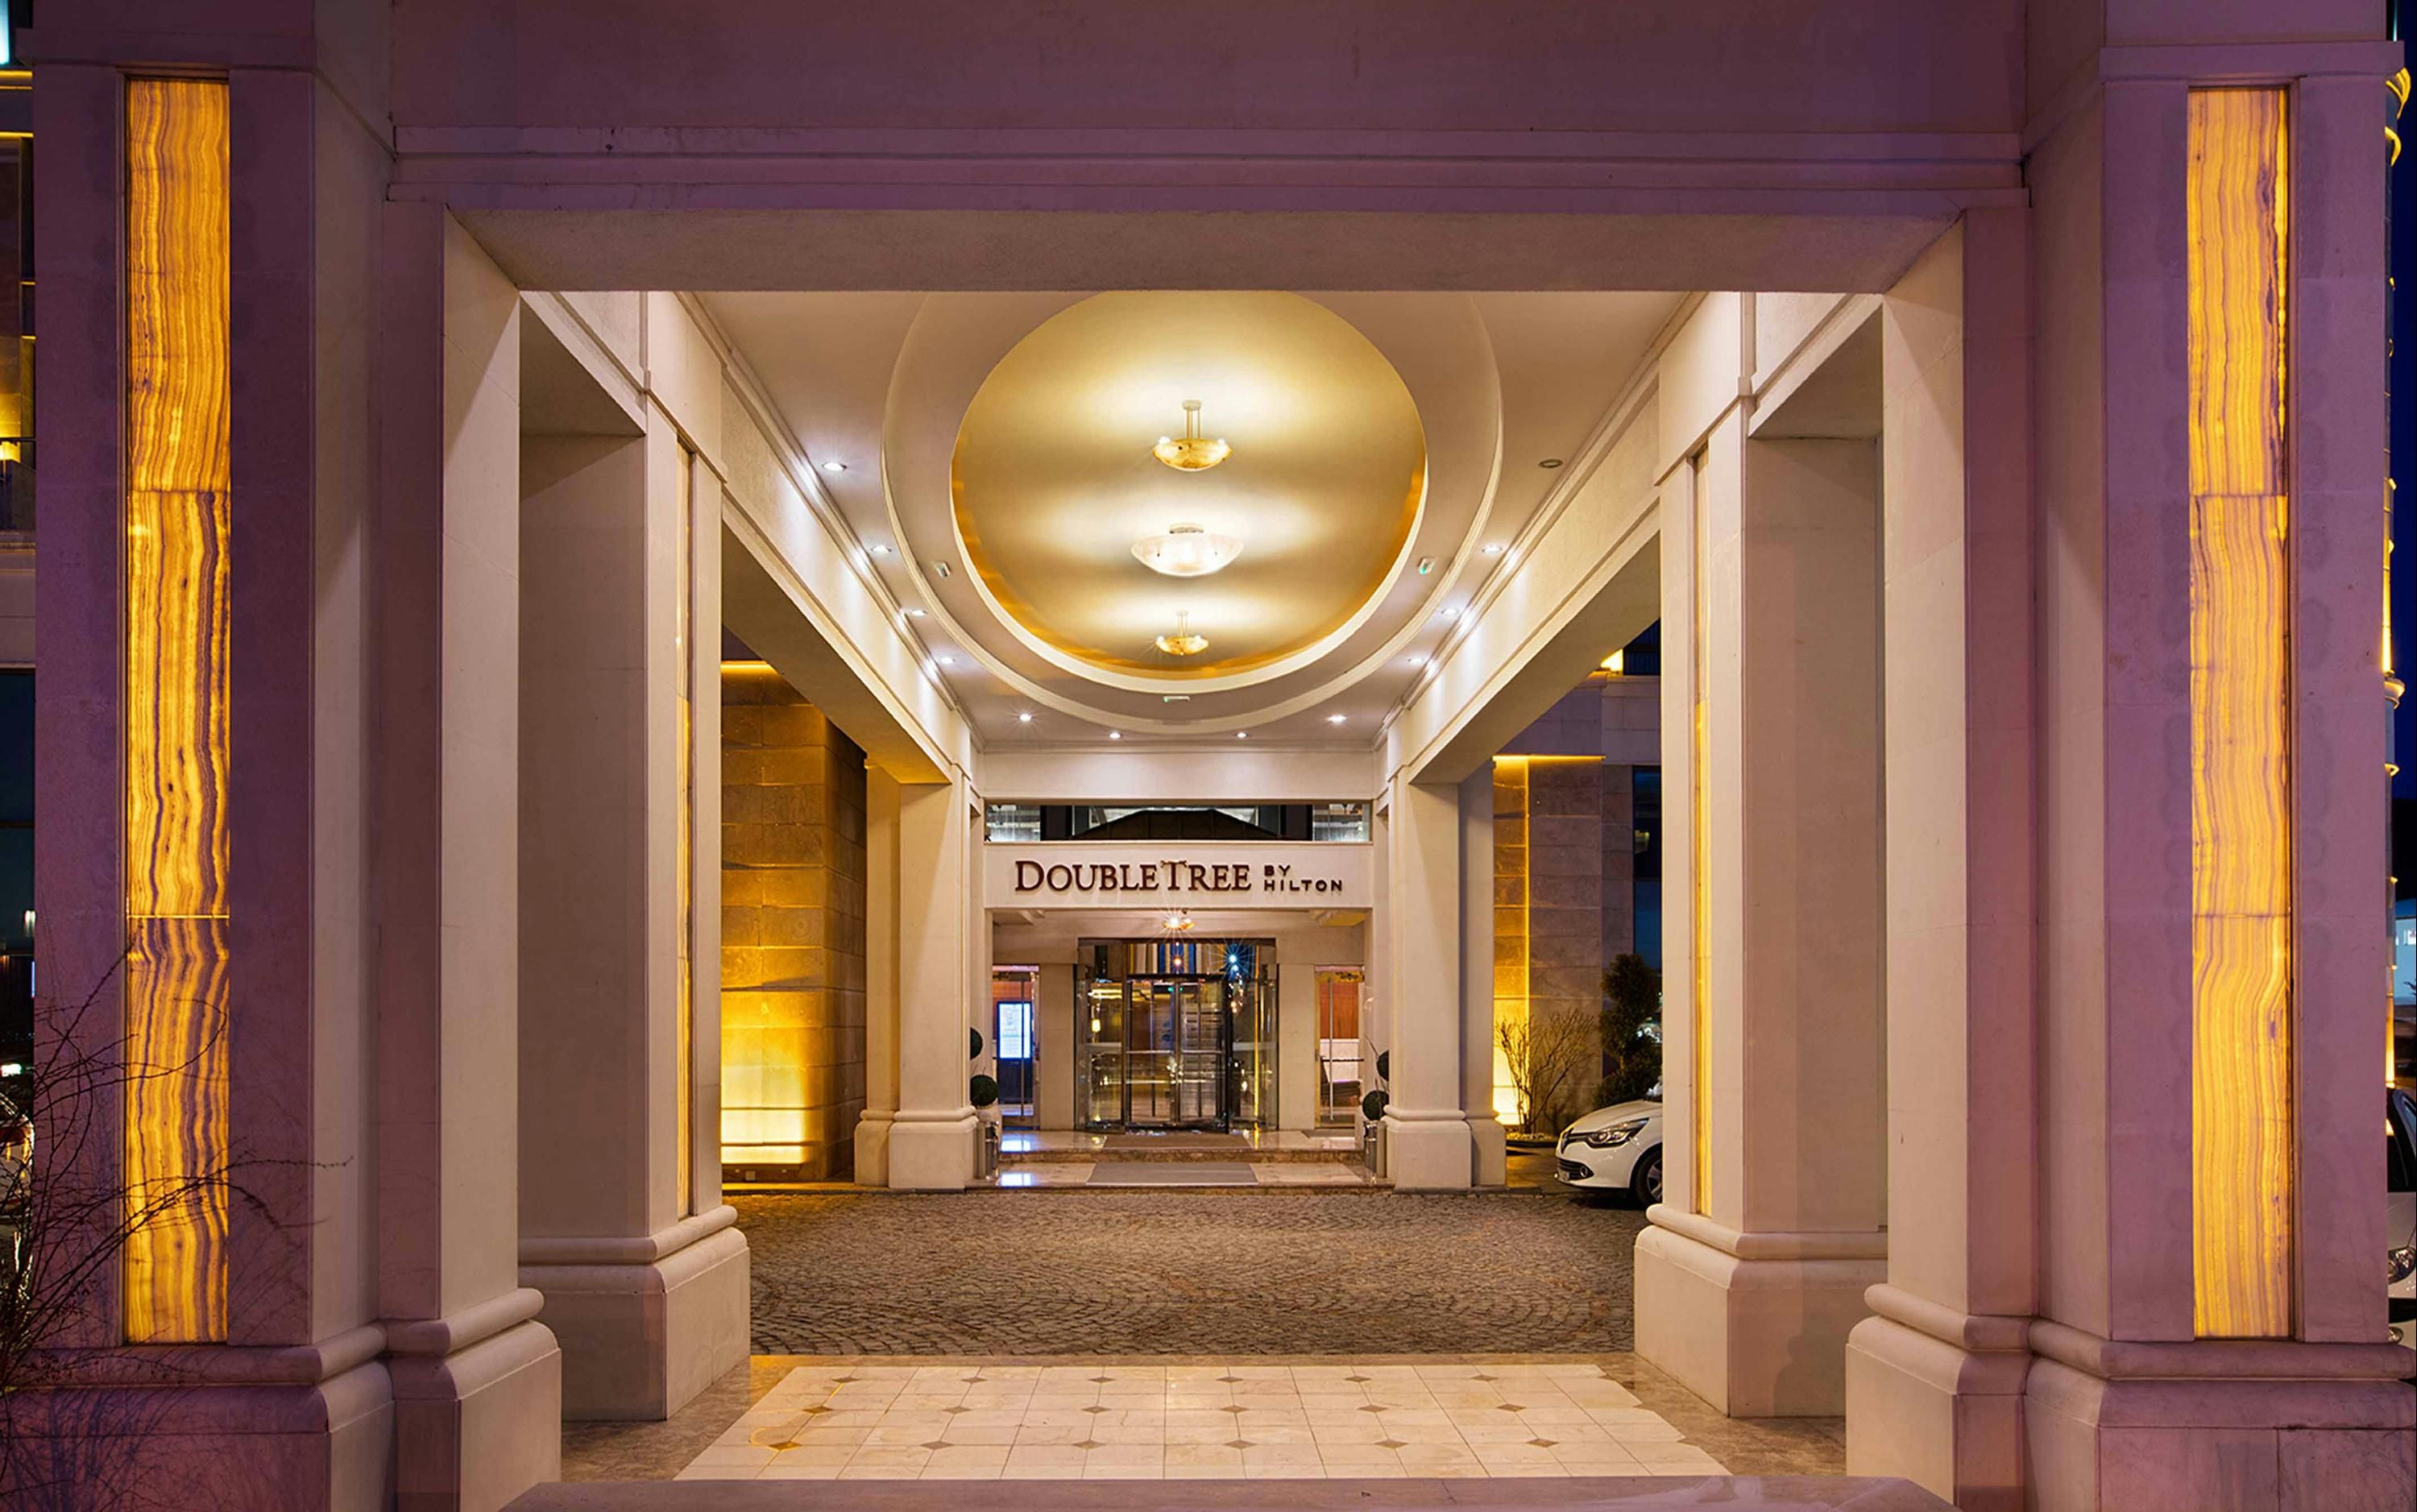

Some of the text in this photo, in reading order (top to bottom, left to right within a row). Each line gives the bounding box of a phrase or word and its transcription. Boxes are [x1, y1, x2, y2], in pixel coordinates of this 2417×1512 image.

[1015, 860, 1252, 891] DOUBLETREE
[1264, 864, 1291, 876] BY
[1264, 880, 1342, 892] HILTON
